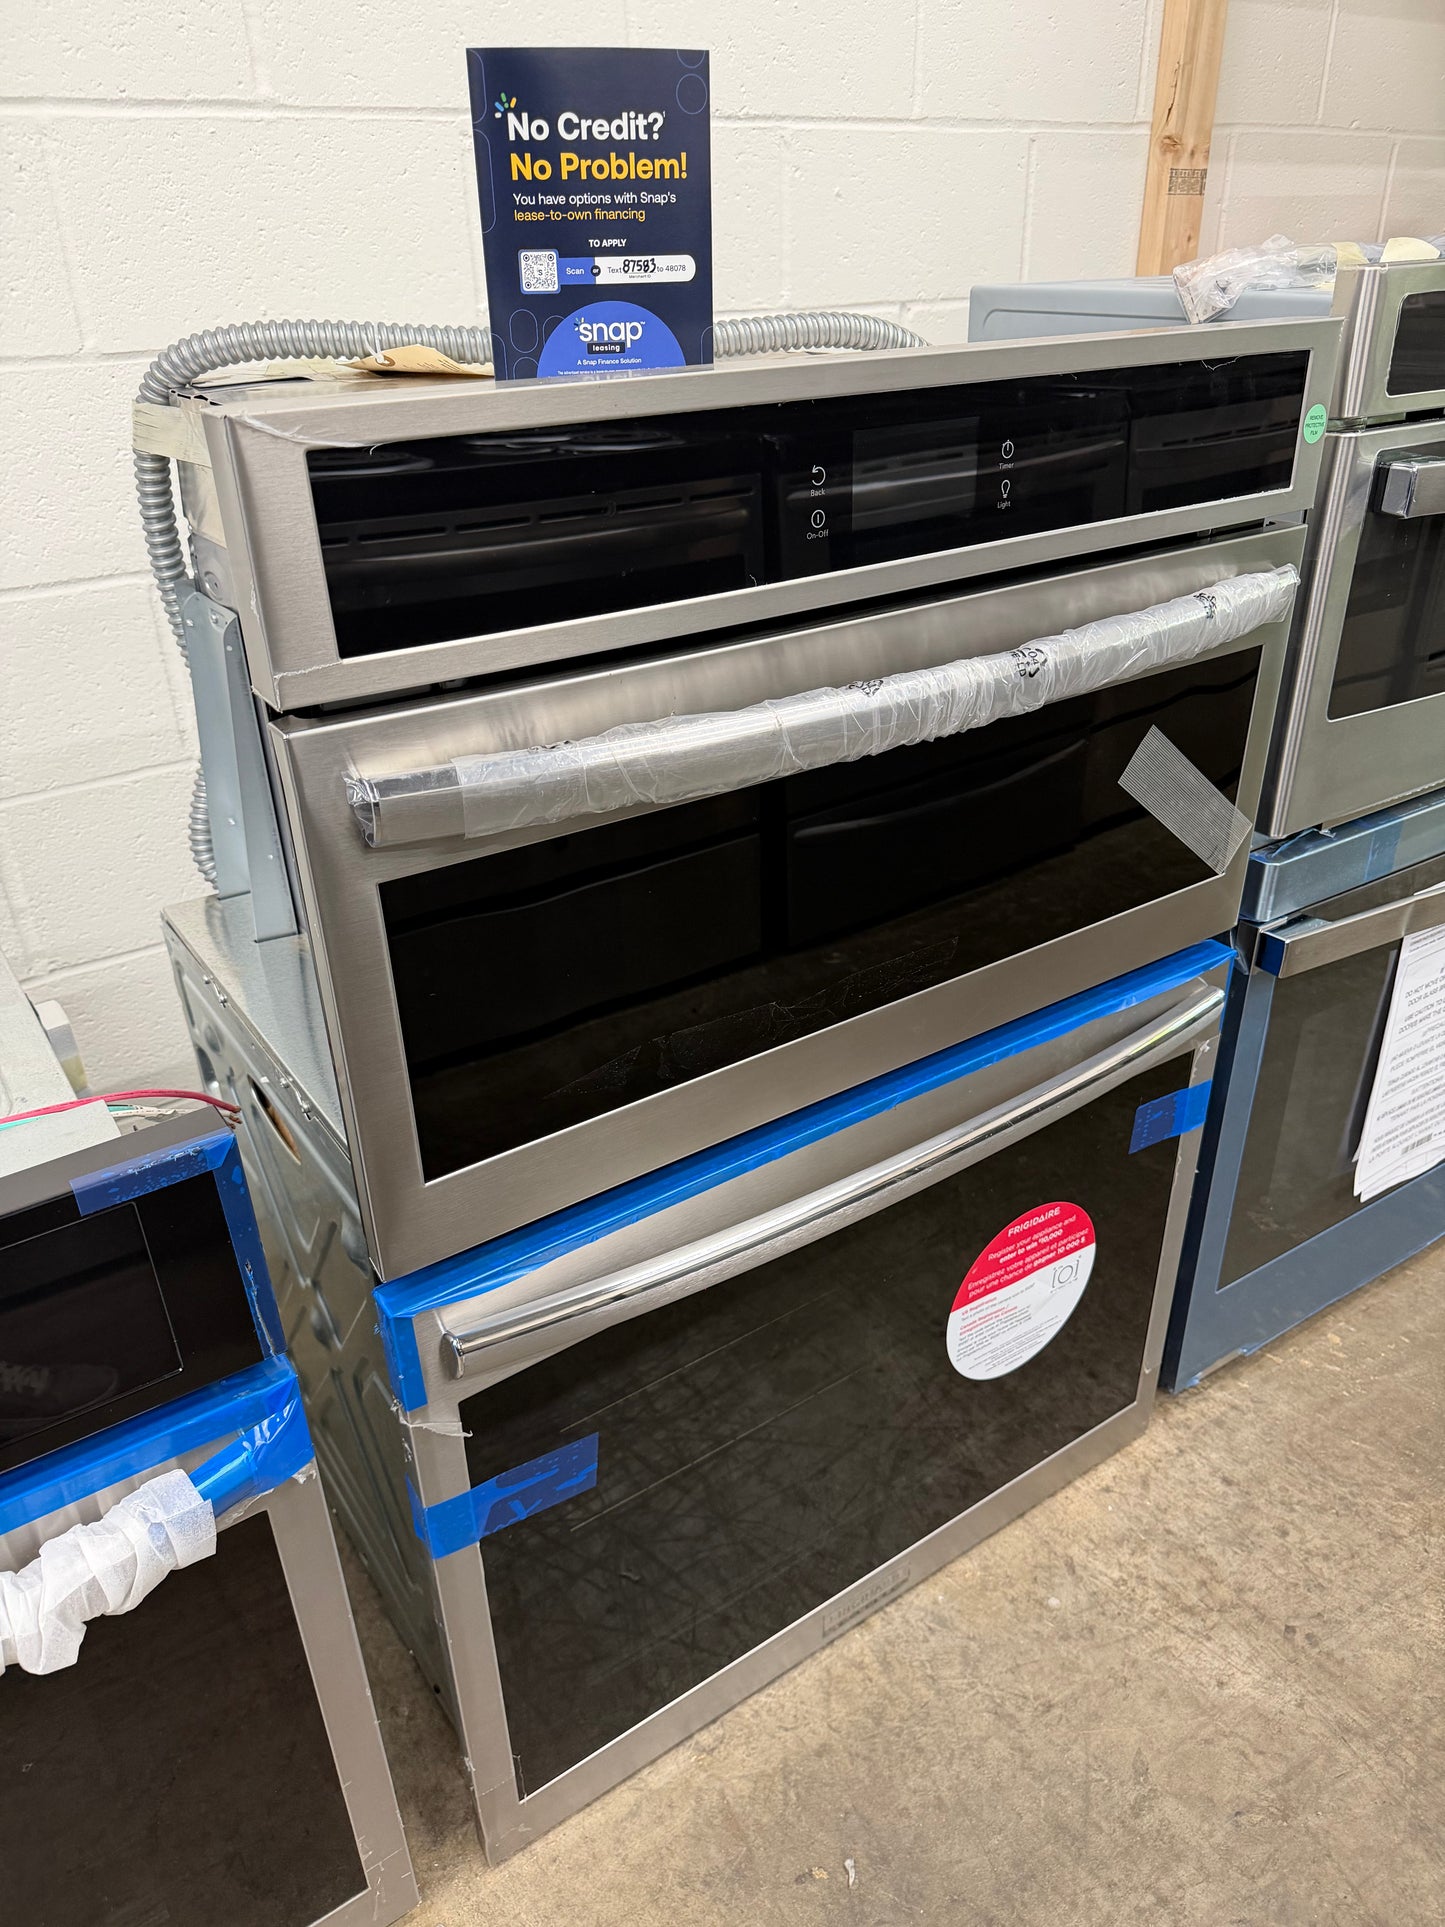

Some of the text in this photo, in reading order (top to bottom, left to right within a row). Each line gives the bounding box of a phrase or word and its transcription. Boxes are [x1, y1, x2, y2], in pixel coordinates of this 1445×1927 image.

[507, 112, 550, 141] No
[510, 151, 688, 181] No Problem!
[513, 191, 677, 208] You have options with Snap's
[514, 207, 646, 222] lease-to-own financing
[588, 238, 627, 247] TO APPLY
[566, 266, 585, 275] Scan
[607, 266, 622, 274] Text
[665, 264, 686, 272] 48078
[622, 257, 657, 273] 87583
[592, 344, 620, 352] leasing
[583, 359, 597, 367] Snap
[998, 461, 1014, 469] Timer
[810, 488, 826, 497] Back
[997, 500, 1011, 510] Light
[806, 529, 829, 540] On-Off
[1008, 1206, 1061, 1237] FRIGIDAIRE
[988, 1214, 1077, 1261] Register your appliance and
[967, 1268, 1006, 1291] Enregistrez
[1007, 1258, 1024, 1272] votre
[1024, 1244, 1050, 1263] appareil
[1050, 1242, 1058, 1250] et
[1058, 1228, 1089, 1247] participez
[999, 1251, 1017, 1264] enter
[1018, 1246, 1026, 1255] to
[1026, 1241, 1038, 1251] win
[969, 1236, 1086, 1299] pour une chance de gagner 10 000 $
